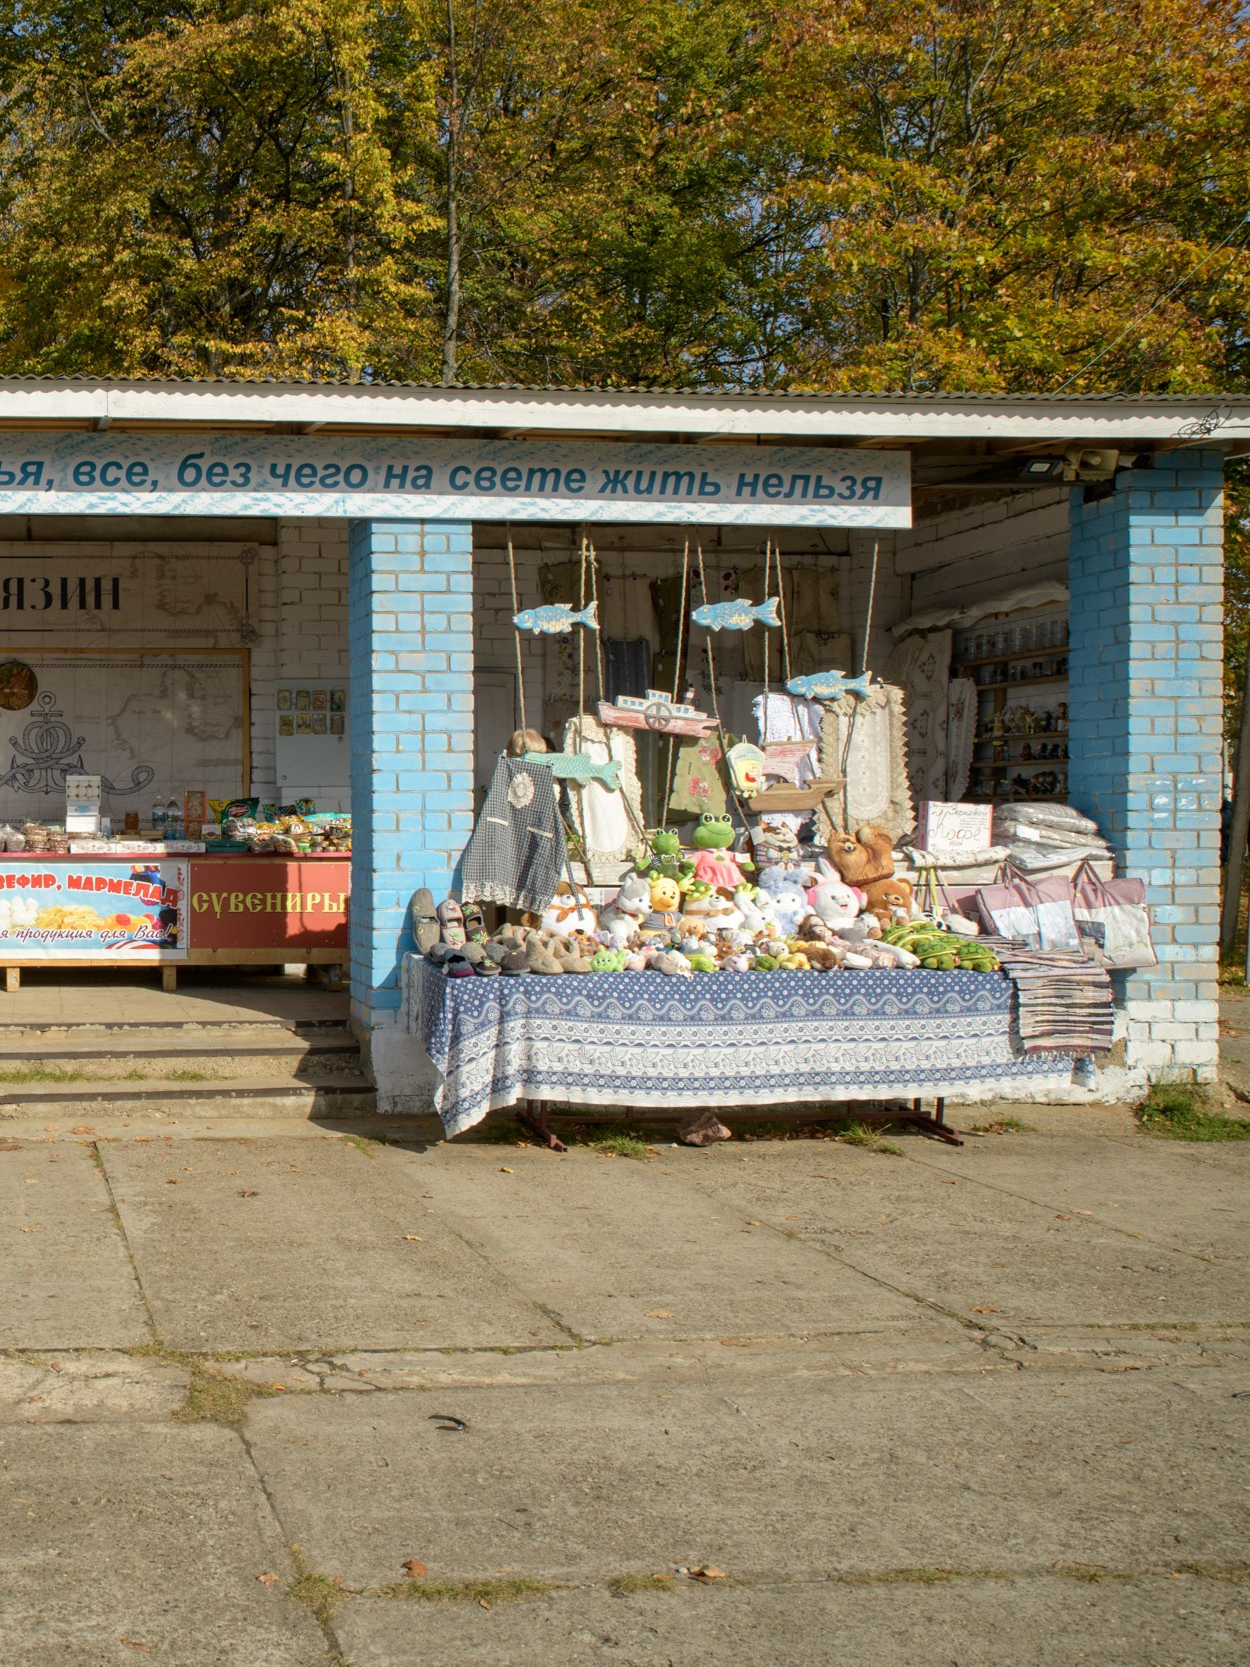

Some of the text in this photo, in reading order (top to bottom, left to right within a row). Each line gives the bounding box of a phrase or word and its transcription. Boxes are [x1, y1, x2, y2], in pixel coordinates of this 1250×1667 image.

[72, 459, 159, 493] все,
[177, 451, 252, 488] без
[269, 462, 369, 490] чего
[383, 464, 433, 490] на
[449, 464, 587, 493] свете
[598, 468, 722, 496] жить
[735, 472, 883, 501] нельзя
[67, 874, 178, 908] МАРМЕЛАД
[192, 891, 347, 919] СУВЕНИРЫ
[15, 928, 93, 943] продукция
[100, 929, 127, 943] для
[134, 923, 172, 940] Вас!
